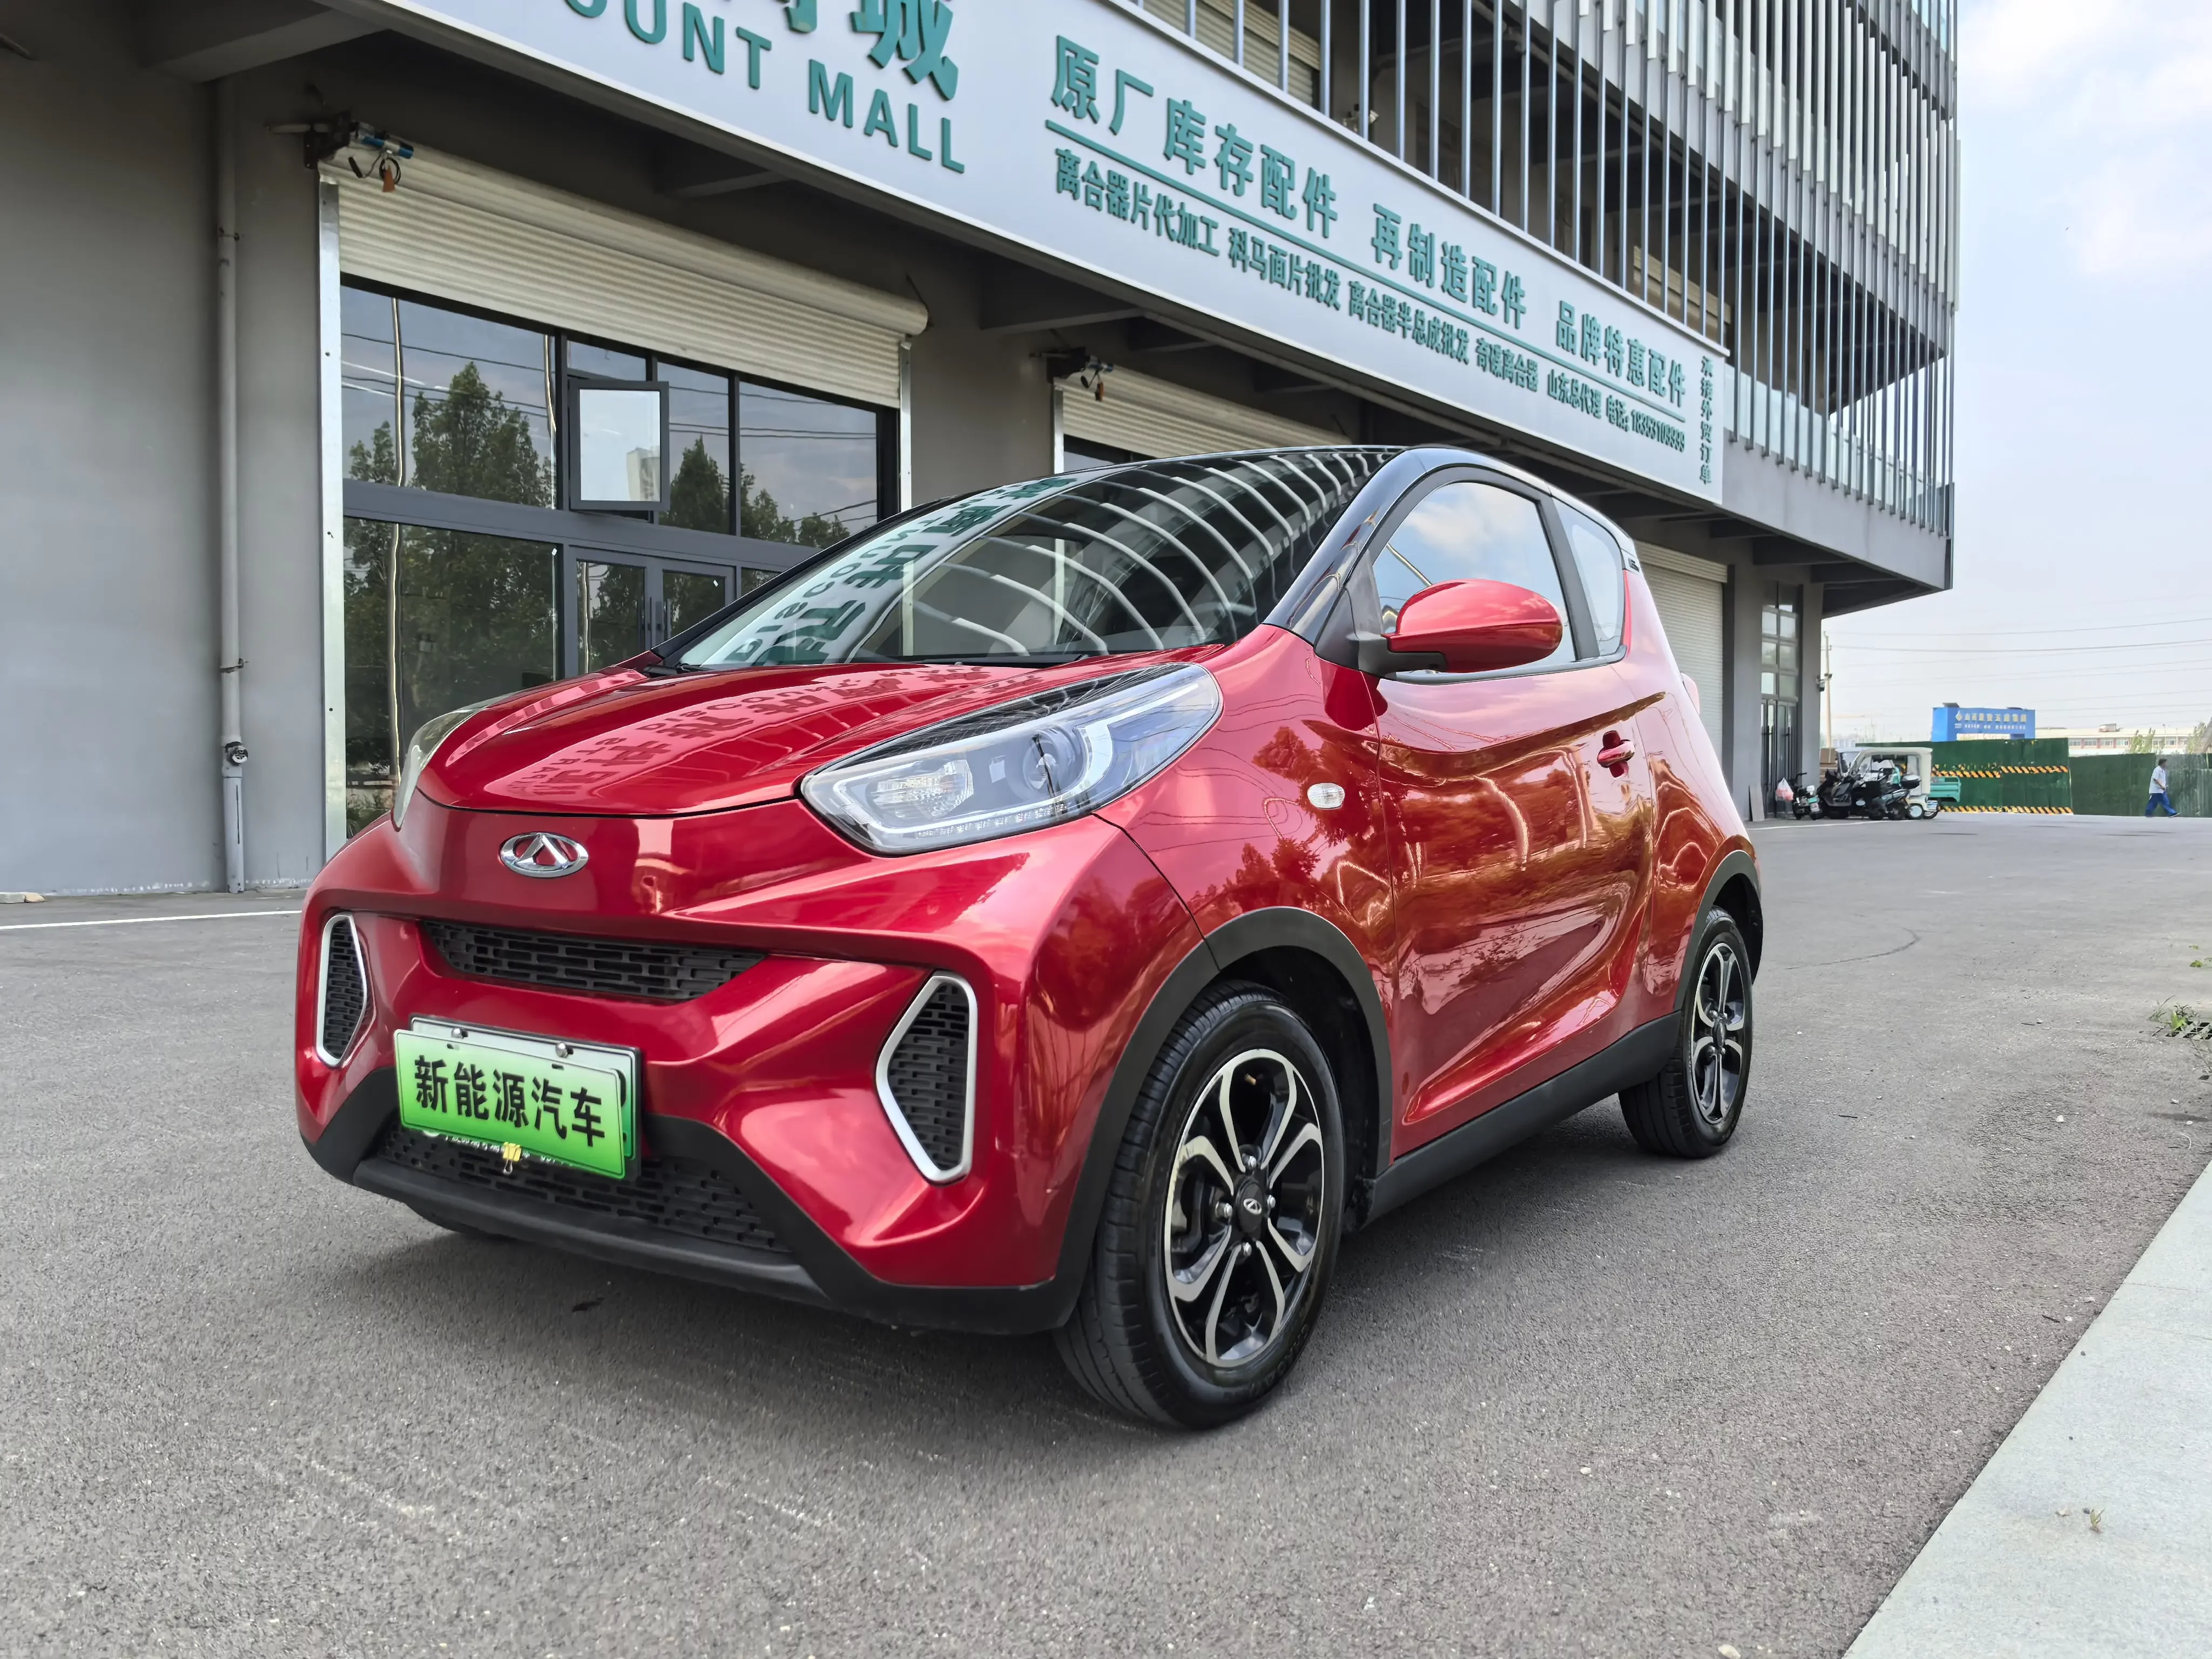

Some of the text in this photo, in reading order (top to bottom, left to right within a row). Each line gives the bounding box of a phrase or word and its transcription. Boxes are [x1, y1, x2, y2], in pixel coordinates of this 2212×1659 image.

[809, 59, 965, 173] MALL
[1050, 35, 1687, 408] 原厂库存配件 再制造配件 品牌特惠配件
[1055, 147, 1220, 257] 离合器片代加工
[1228, 227, 1341, 311] 科马面片批发
[1348, 281, 1469, 365] 离合器半总成批发
[1547, 369, 1602, 419] 山东总代理
[1700, 356, 1714, 485] 承接外贸订单
[414, 1054, 605, 1147] 新能源汽车
